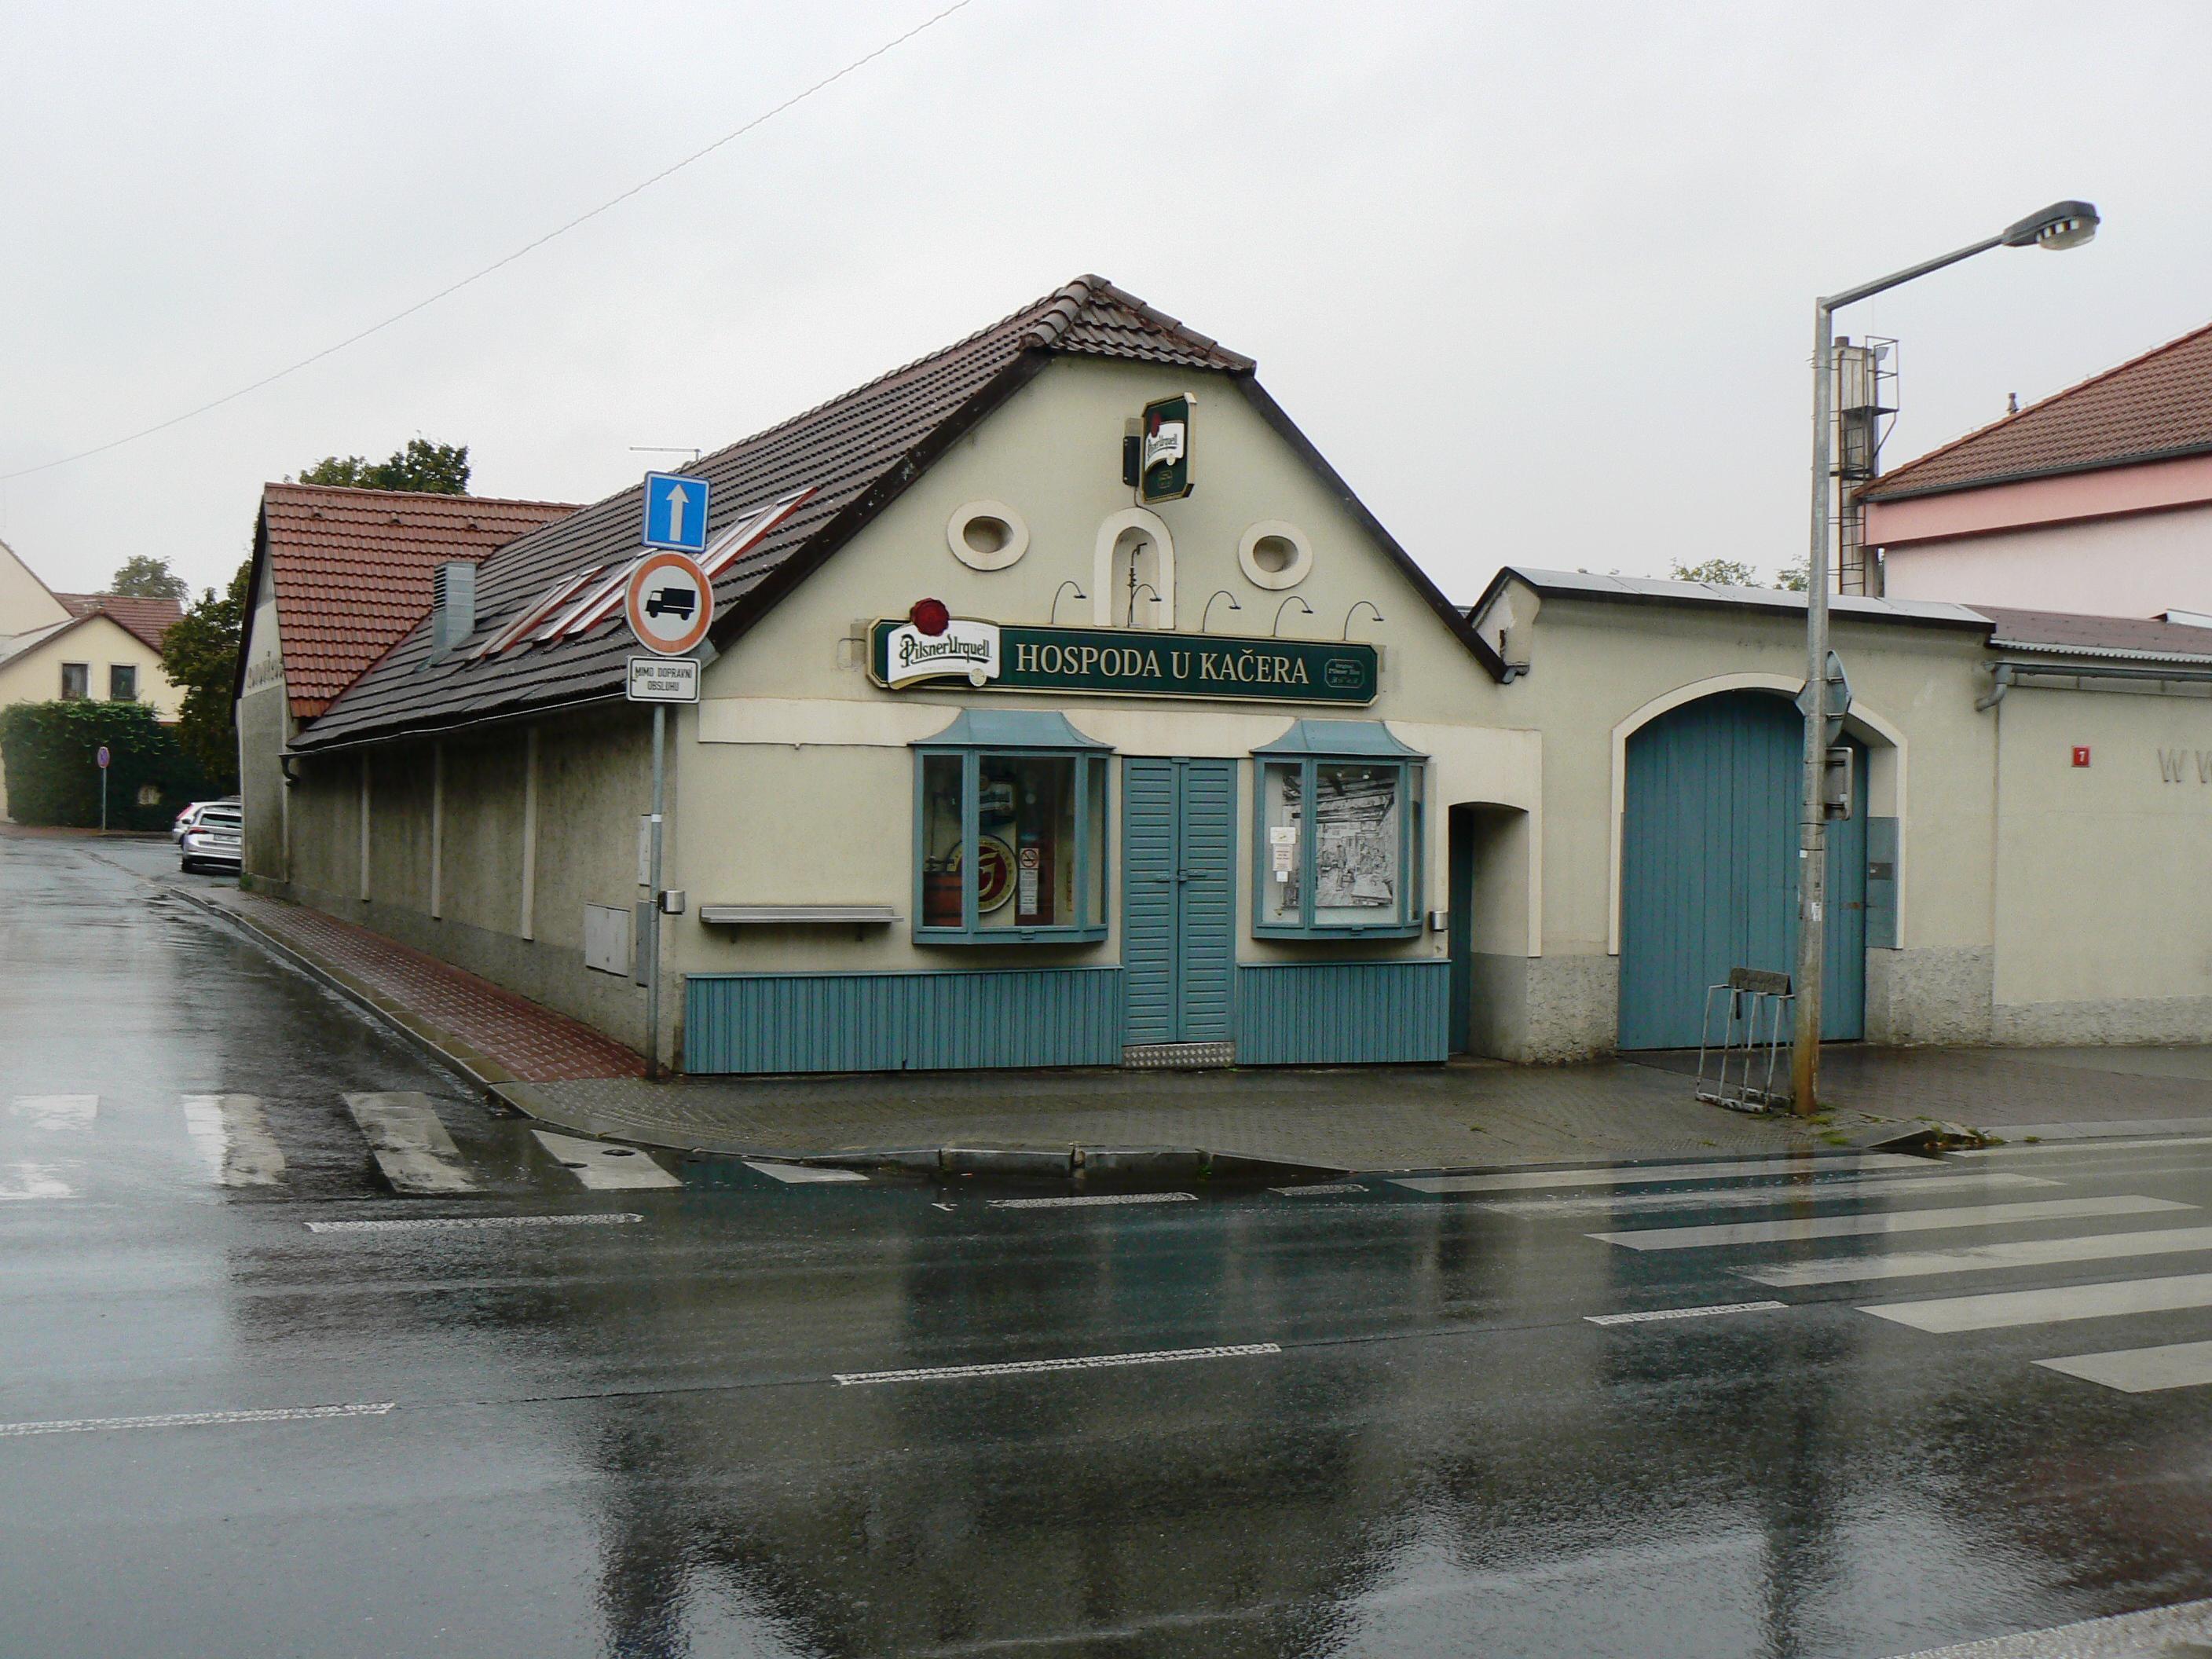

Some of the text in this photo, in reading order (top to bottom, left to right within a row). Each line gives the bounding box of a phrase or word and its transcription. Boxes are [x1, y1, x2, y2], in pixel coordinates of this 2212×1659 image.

[899, 634, 990, 668] Pilsner Urquell
[635, 667, 654, 677] MIMO
[1015, 643, 1309, 684] HOSPODA U KAČERA
[647, 680, 679, 691] OBSLUHU
